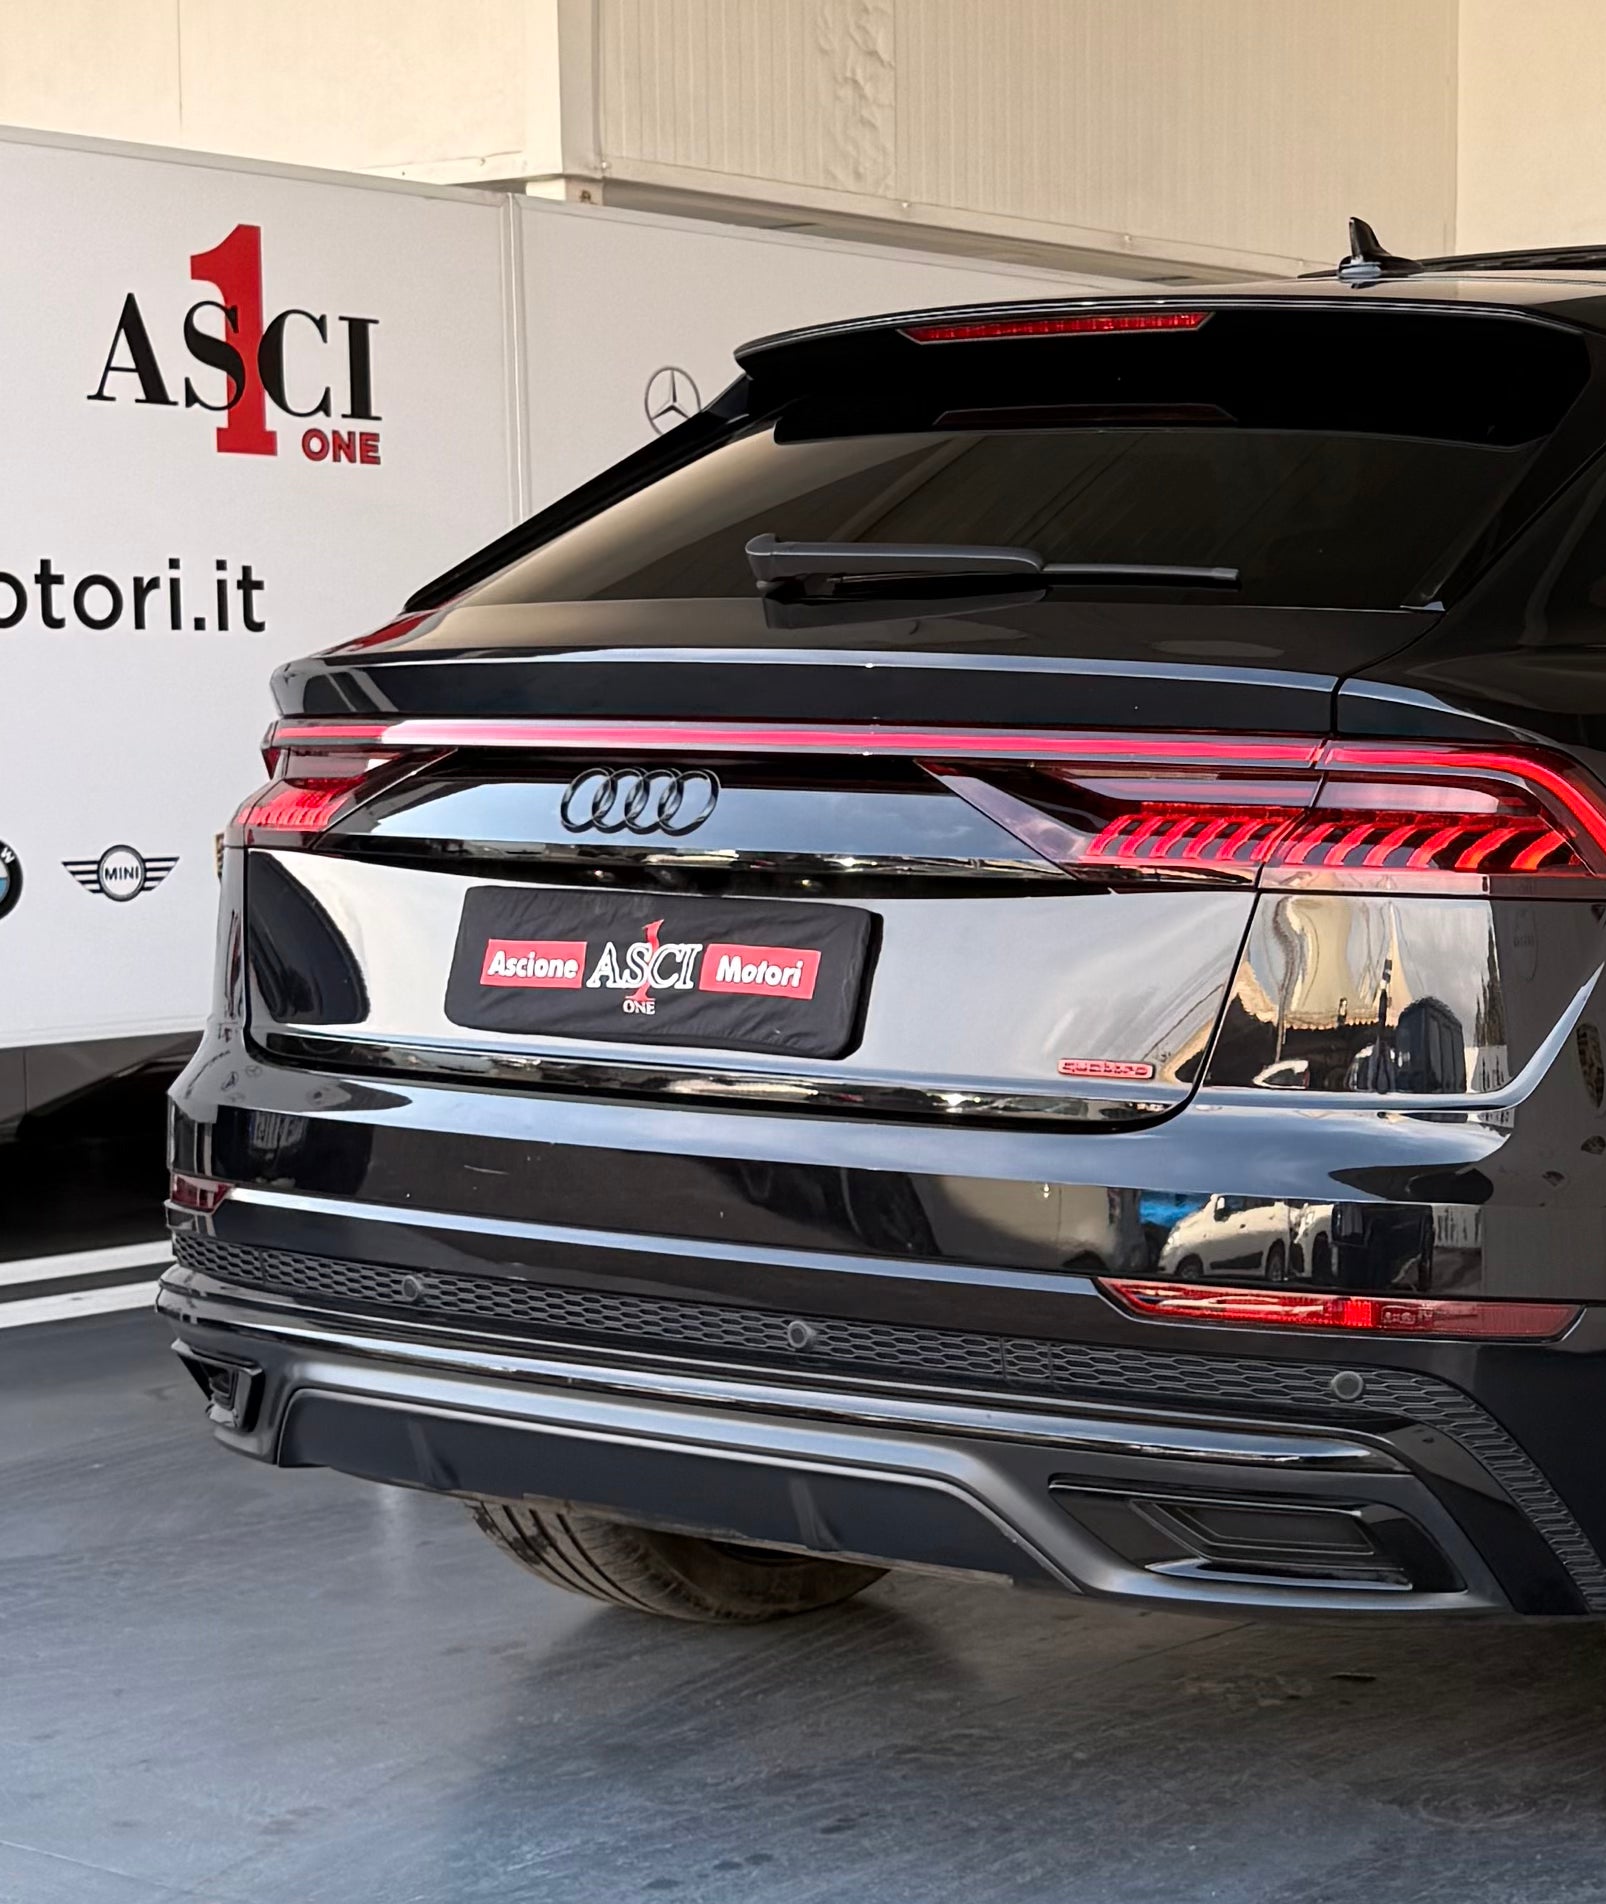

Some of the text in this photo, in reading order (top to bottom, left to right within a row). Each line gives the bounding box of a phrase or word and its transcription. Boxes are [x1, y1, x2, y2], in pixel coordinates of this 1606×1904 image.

[302, 428, 381, 465] ONE
[104, 864, 140, 882] MINI
[487, 949, 579, 980] Ascione
[716, 955, 803, 988] Motori
[623, 998, 656, 1015] ONE
